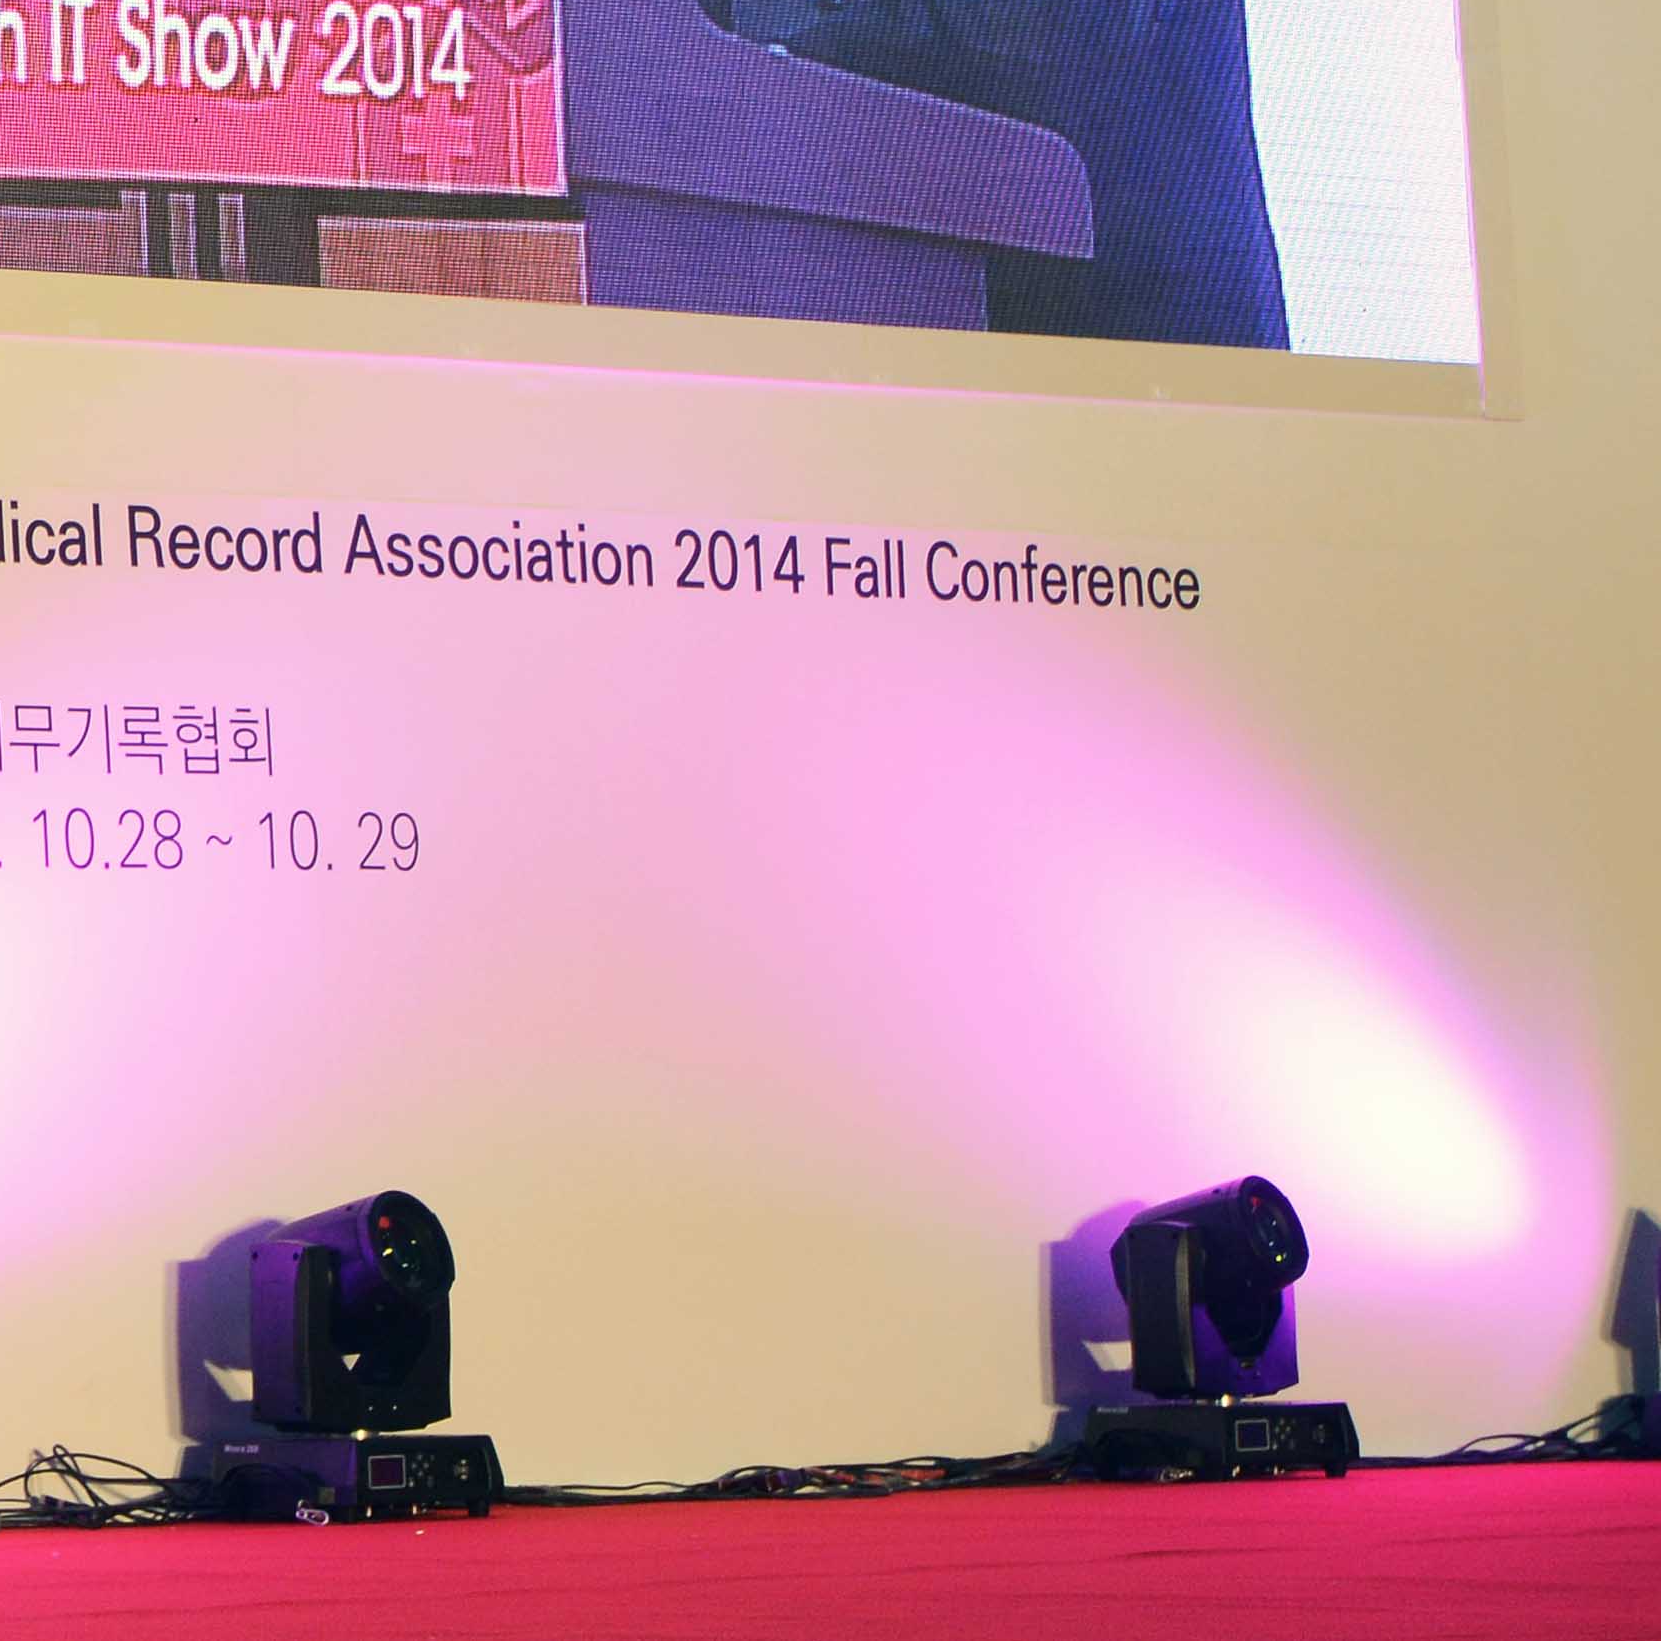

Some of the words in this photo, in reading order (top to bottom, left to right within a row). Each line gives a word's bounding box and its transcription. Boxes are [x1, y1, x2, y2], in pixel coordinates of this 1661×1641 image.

[320, 0, 472, 98] 2014
[128, 505, 323, 573] Record
[344, 514, 653, 587] Association
[675, 529, 805, 594] 2014
[825, 537, 905, 599] Fall
[926, 541, 1200, 610] Conference
[33, 807, 184, 871] 10.28
